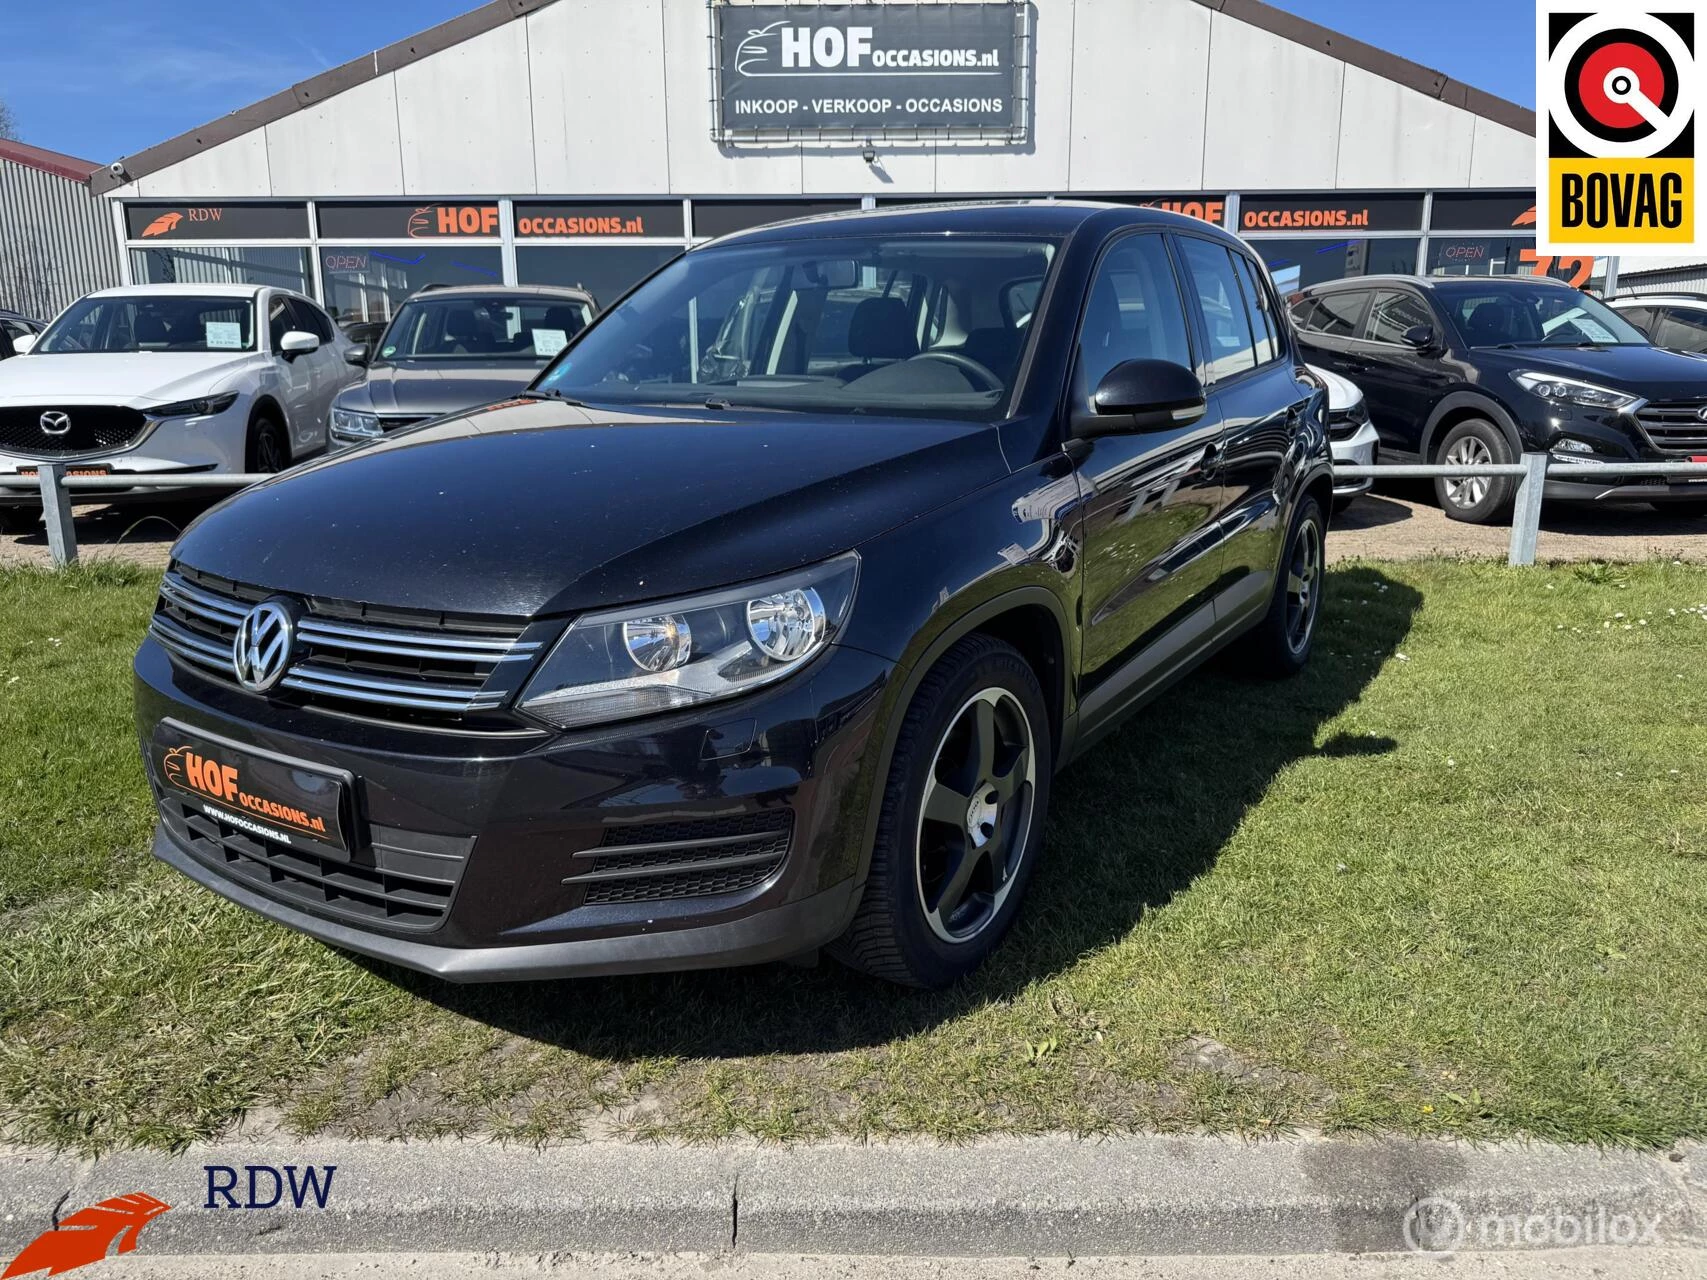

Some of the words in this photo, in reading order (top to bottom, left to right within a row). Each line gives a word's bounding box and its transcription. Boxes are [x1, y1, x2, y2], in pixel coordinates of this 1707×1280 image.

[781, 26, 873, 68] HOF
[873, 49, 999, 67] OCCASIONS.nl
[735, 99, 799, 114] INKOOP
[812, 99, 892, 114] VERKOOP
[905, 98, 1003, 113] OCCASIONS
[188, 208, 223, 222] RDW
[436, 207, 498, 234] HOF
[518, 216, 644, 235] OCCASIONS.nl
[1243, 209, 1369, 228] OCCASIONS.nl
[1445, 246, 1485, 258] OPEN
[325, 255, 367, 269] OPEN
[185, 752, 239, 801] HOF
[239, 791, 327, 833] OCCASIONS.nl
[202, 803, 292, 844] WWW.HOFOCCASIONS.NL
